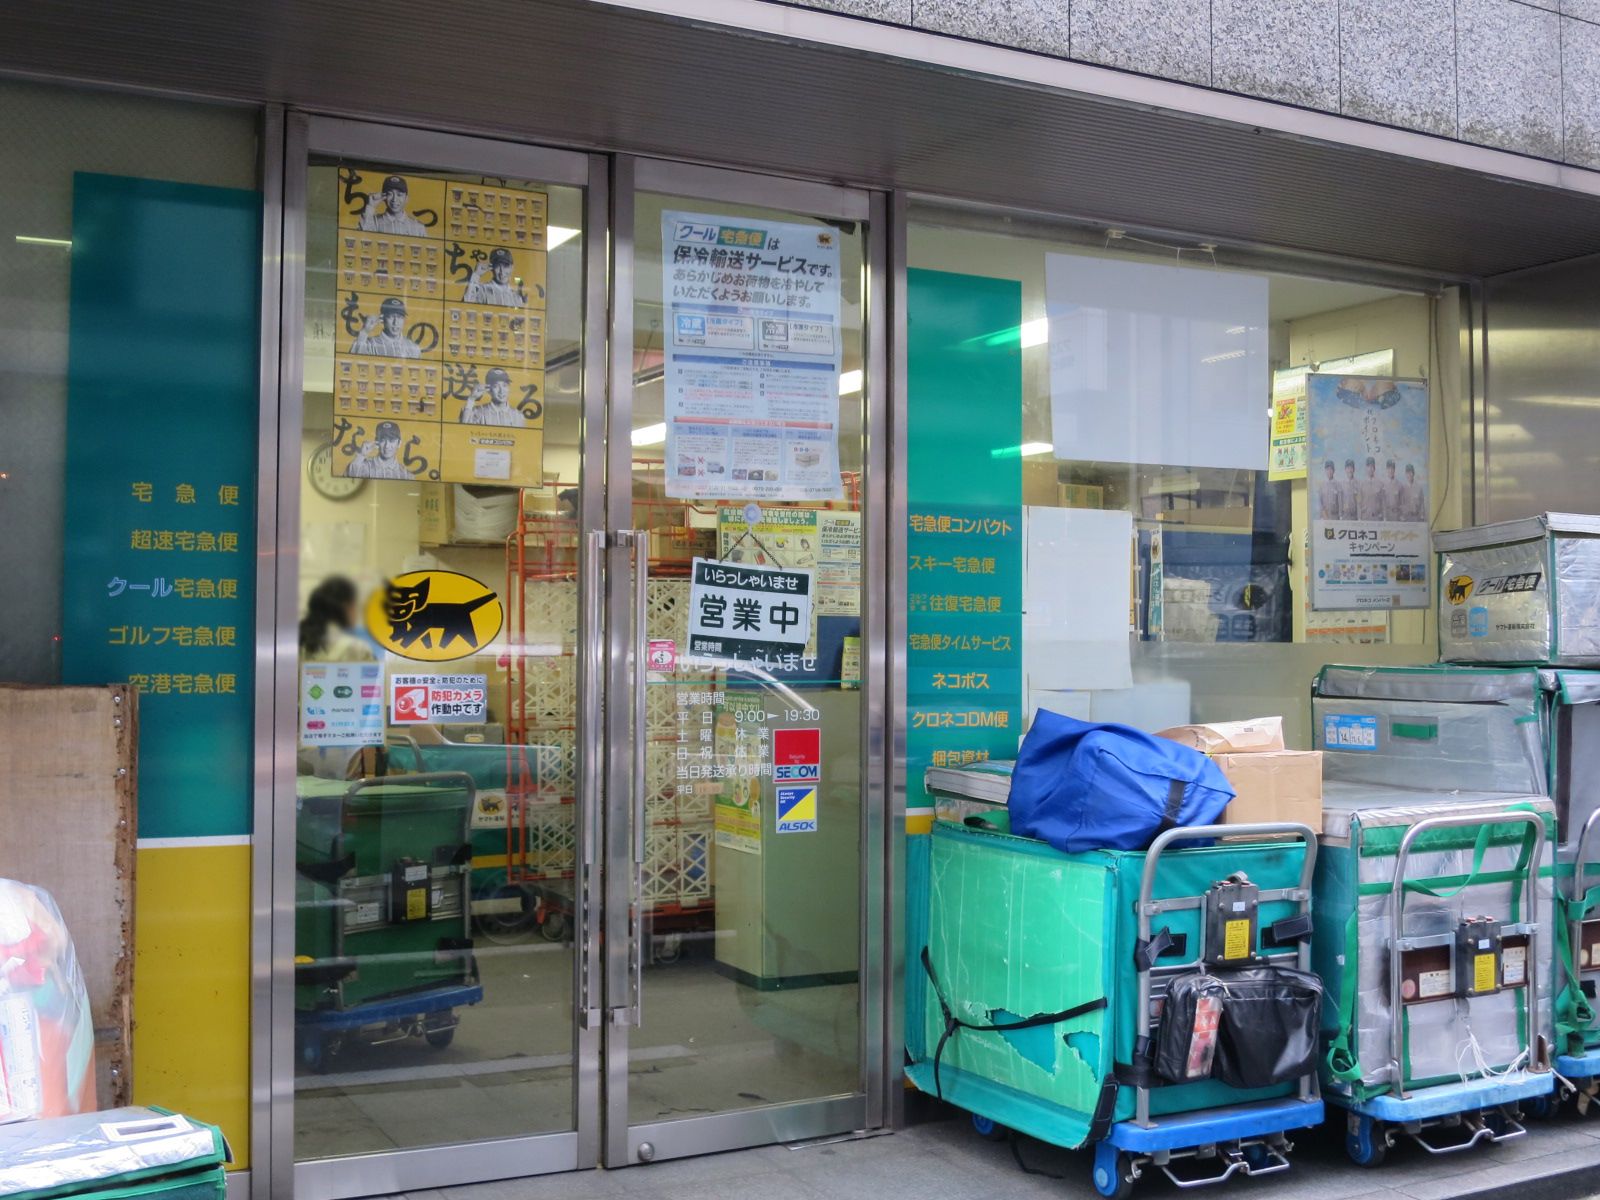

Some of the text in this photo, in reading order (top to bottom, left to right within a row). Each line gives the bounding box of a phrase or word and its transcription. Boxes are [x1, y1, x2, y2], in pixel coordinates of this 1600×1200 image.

[673, 245, 833, 278] 保冷輸送サービスです。
[673, 268, 824, 294] あらかじめお荷物を冷やして
[673, 286, 813, 308] いただくようお願いします。
[131, 482, 239, 505] 宅急便
[909, 514, 1012, 536] 宅急便コンパクト
[130, 529, 239, 552] 超速宅急便
[1350, 542, 1396, 552] キャンペーン
[909, 556, 996, 574] スキー宅急便
[704, 567, 799, 590] いらっしゃいませ
[107, 577, 238, 600] クール宅急便
[700, 593, 799, 634] 営業中
[108, 626, 236, 647] ゴルフ宅急便
[909, 633, 1011, 652] 宅急便タイムサービス
[129, 673, 236, 694] 空港宅急便
[932, 672, 990, 689] ネコポス
[431, 690, 482, 702] 防犯カメラ
[676, 691, 725, 705] 営業時間
[431, 703, 482, 715] 作動中です
[735, 710, 765, 722] 9:00
[784, 709, 820, 722] 19:30
[912, 711, 1009, 728] クロネコDM便
[676, 763, 772, 780] 当日発送承り時間
[777, 766, 817, 778] SECOM
[779, 821, 814, 832] ALSOK
